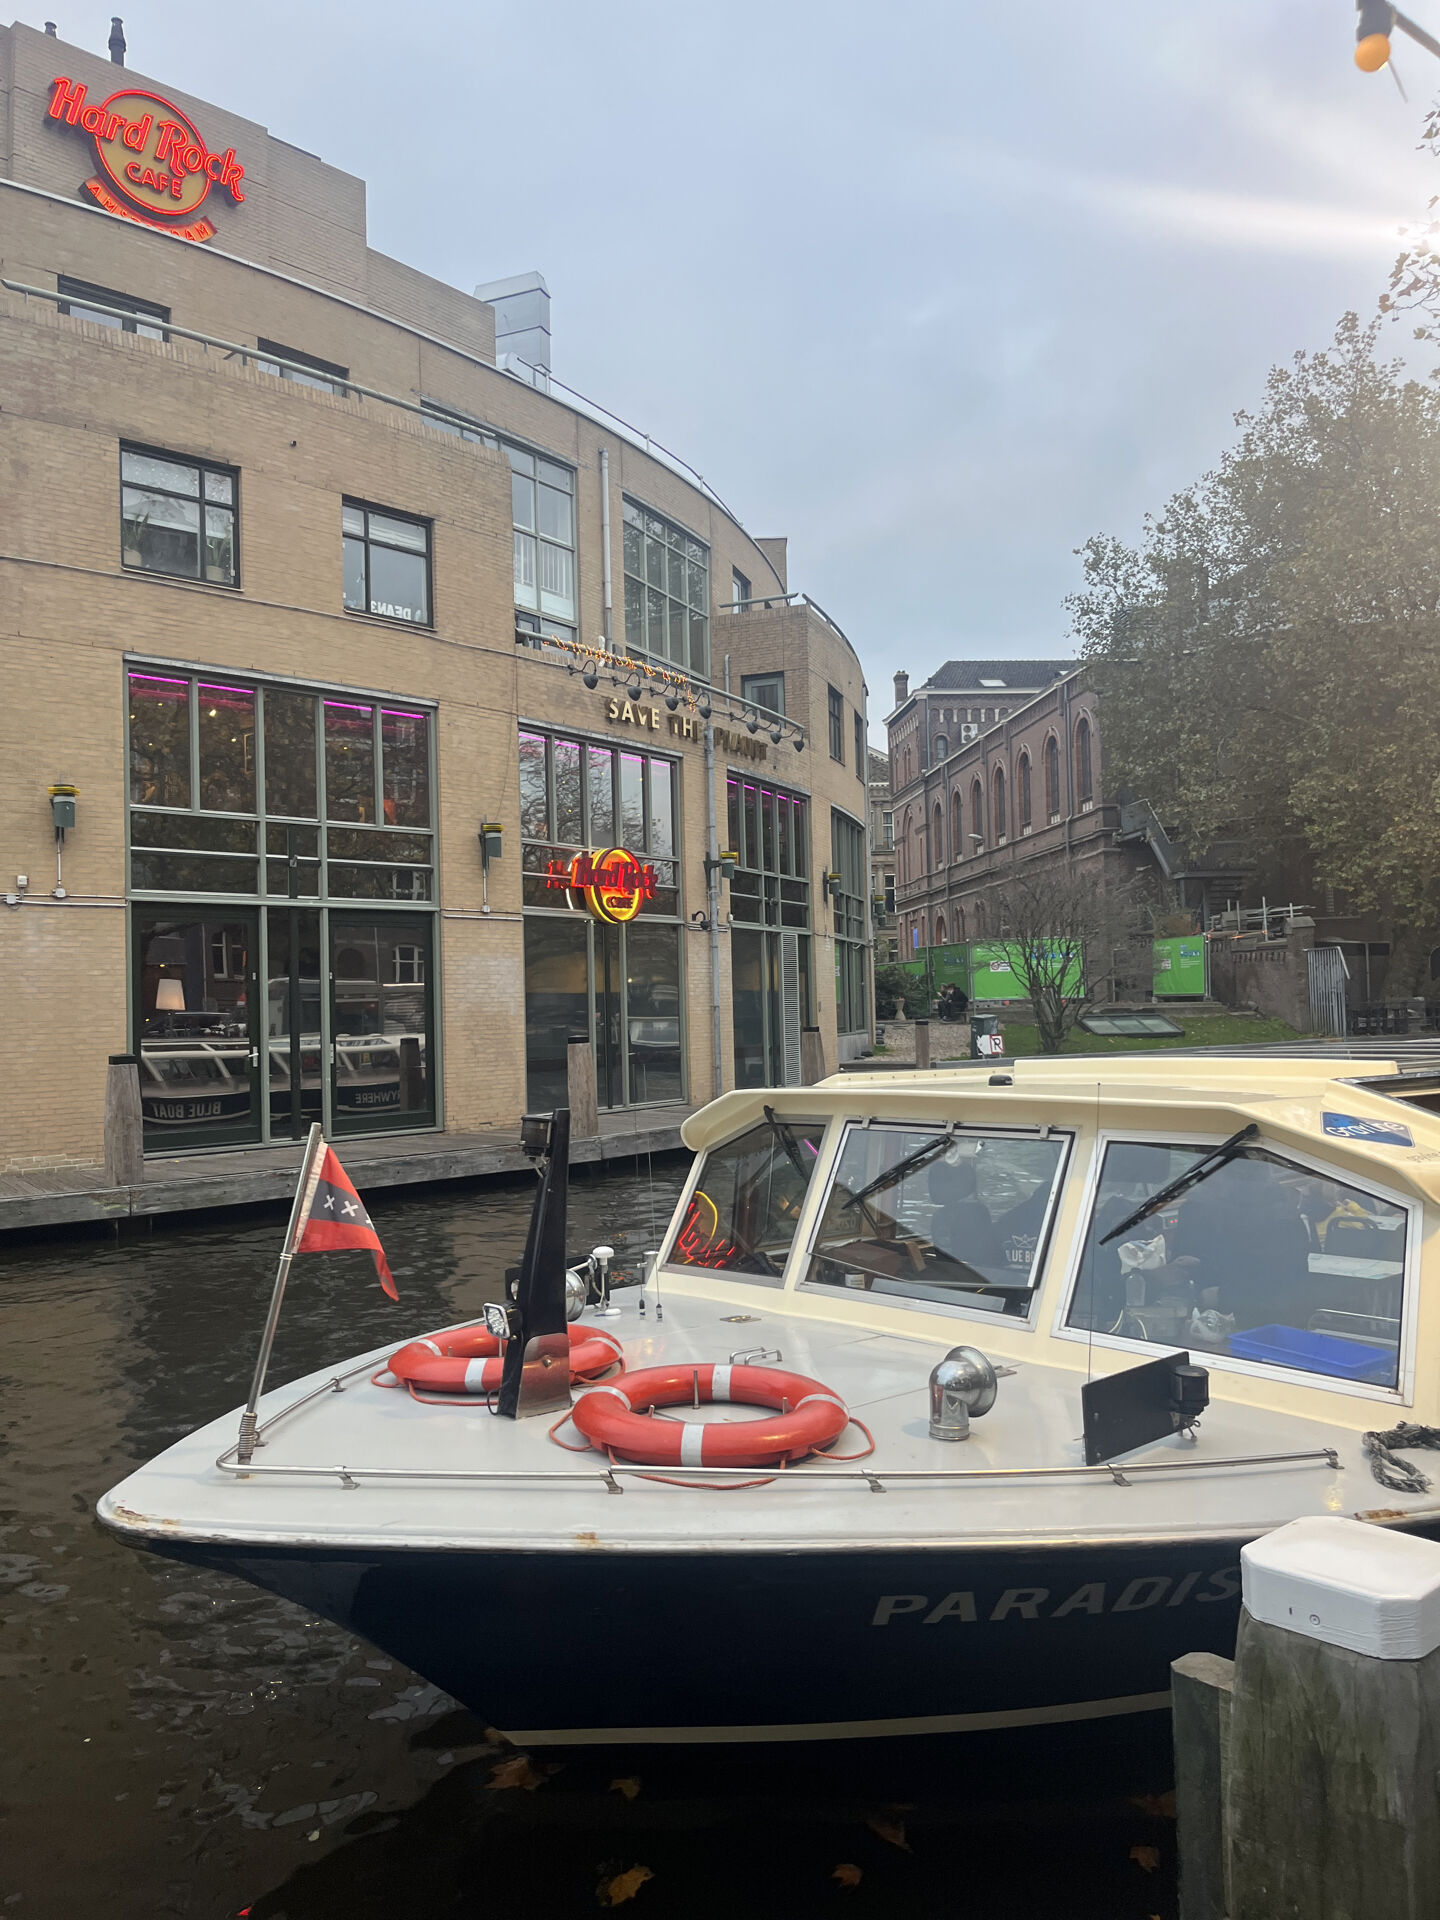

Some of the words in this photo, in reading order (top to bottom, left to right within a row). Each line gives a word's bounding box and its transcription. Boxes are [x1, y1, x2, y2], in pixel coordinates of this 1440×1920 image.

[49, 76, 154, 152] Hard
[154, 119, 246, 203] Rock
[125, 161, 183, 199] CAFE
[606, 697, 660, 732] SAVE
